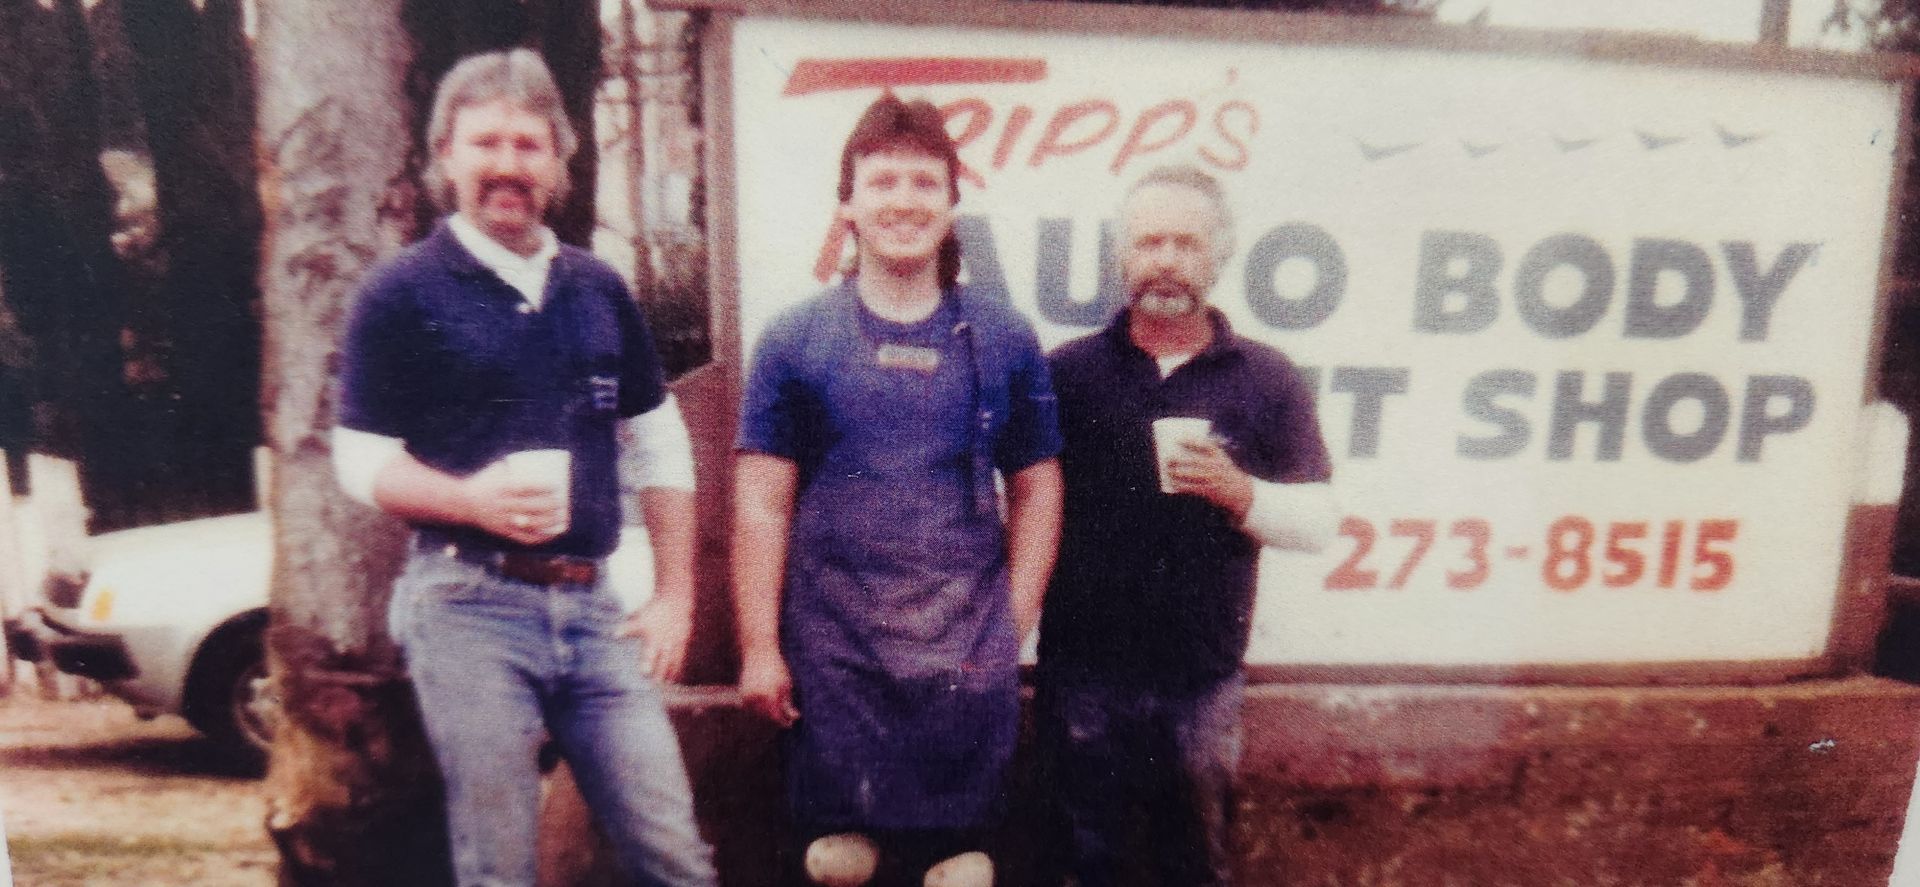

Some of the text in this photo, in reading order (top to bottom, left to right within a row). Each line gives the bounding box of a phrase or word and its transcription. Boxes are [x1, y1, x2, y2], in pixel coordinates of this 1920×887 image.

[948, 214, 1822, 342] AUO BODY
[1455, 367, 1817, 463] SHOP
[1323, 513, 1740, 592] 273-8515
